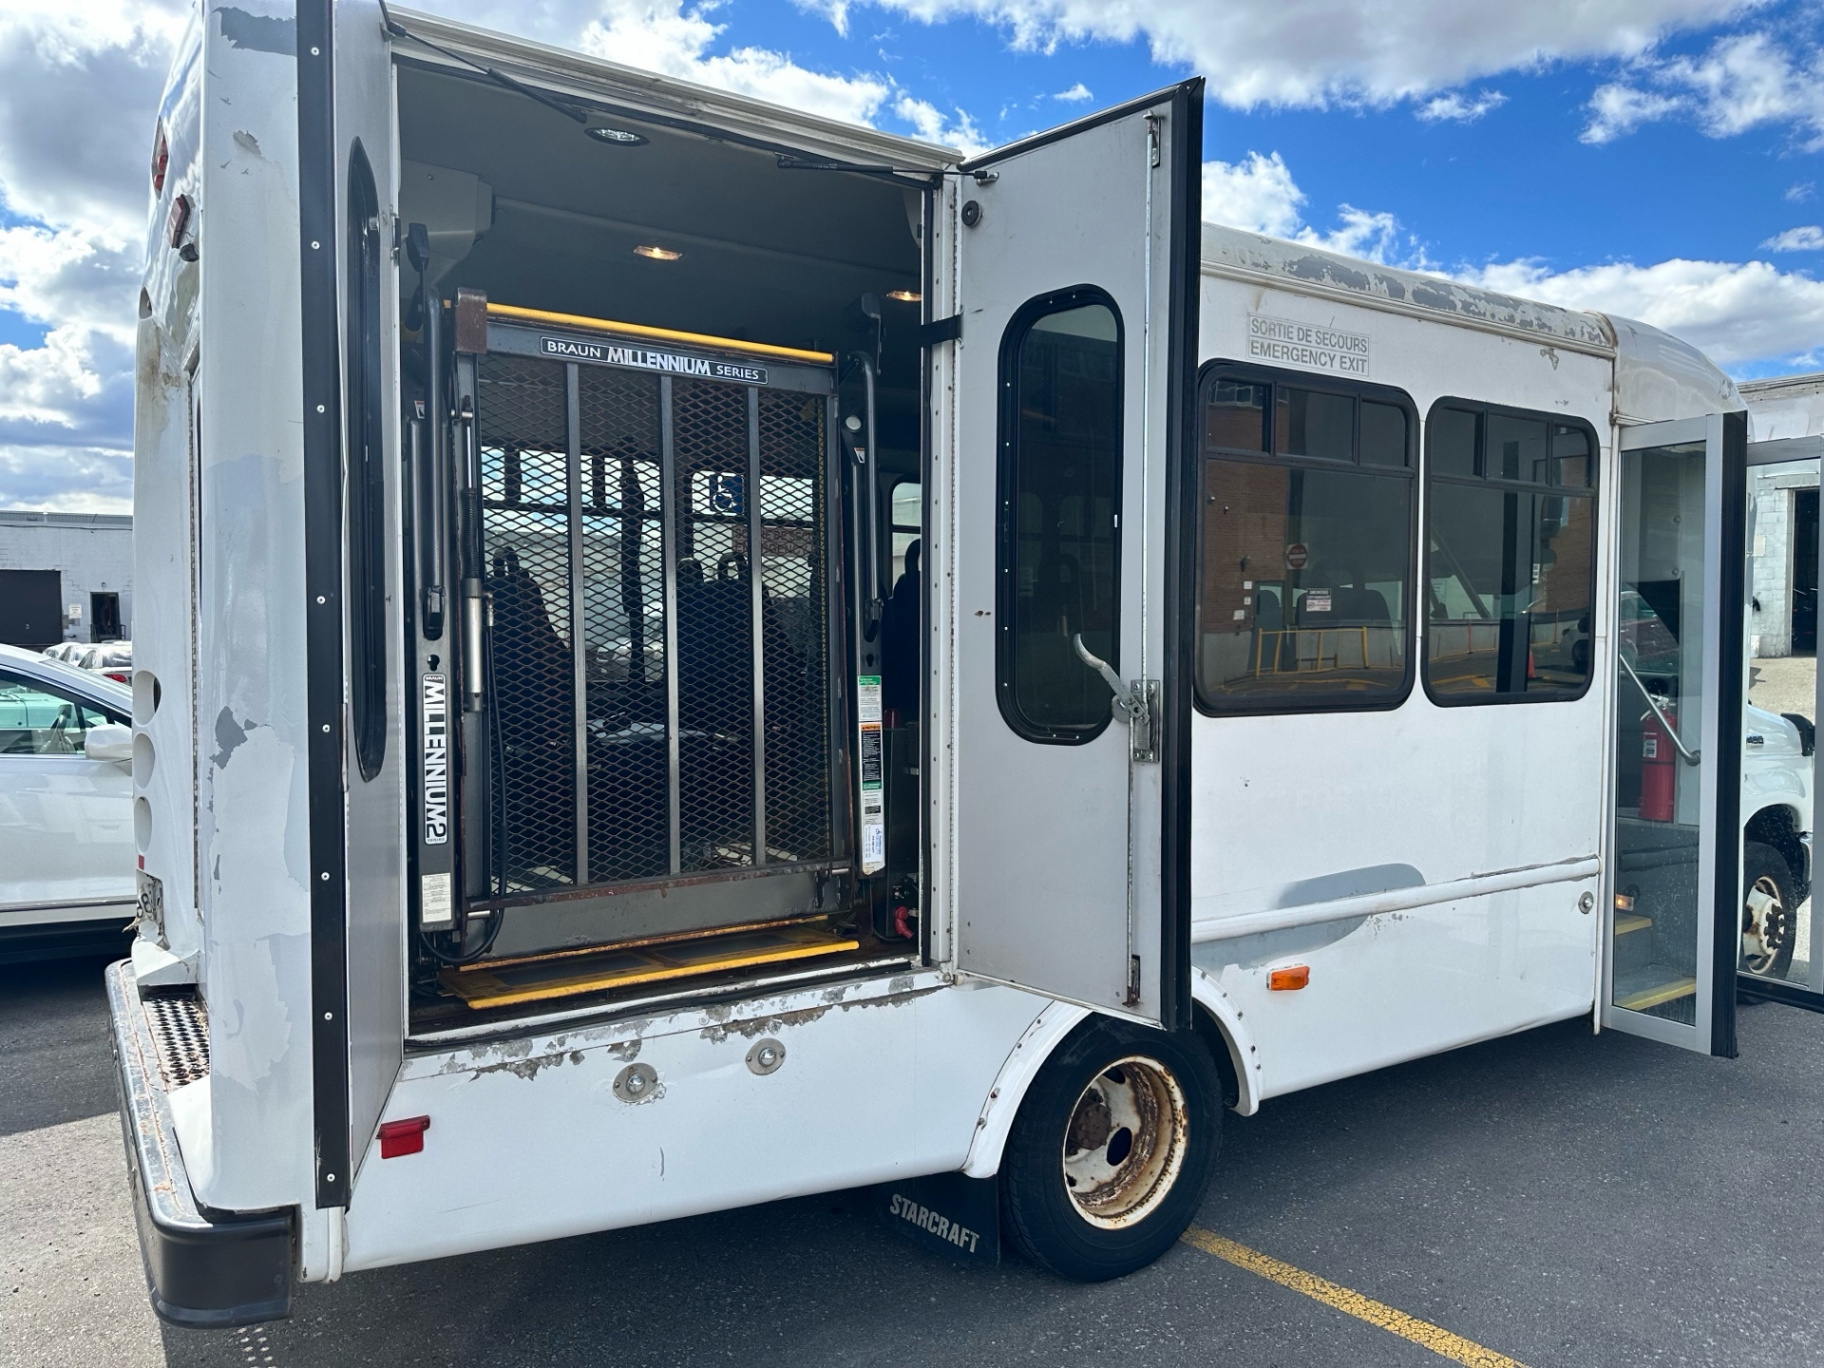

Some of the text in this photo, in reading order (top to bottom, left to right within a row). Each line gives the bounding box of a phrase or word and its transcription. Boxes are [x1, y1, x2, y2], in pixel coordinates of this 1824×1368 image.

[1251, 318, 1367, 353] SORTIE DE SECOURS
[547, 341, 759, 379] BRAUN MILLENNIUM SERIES
[1251, 341, 1367, 373] EMERGENCY EXIT
[889, 1193, 980, 1253] STARCRAFT
